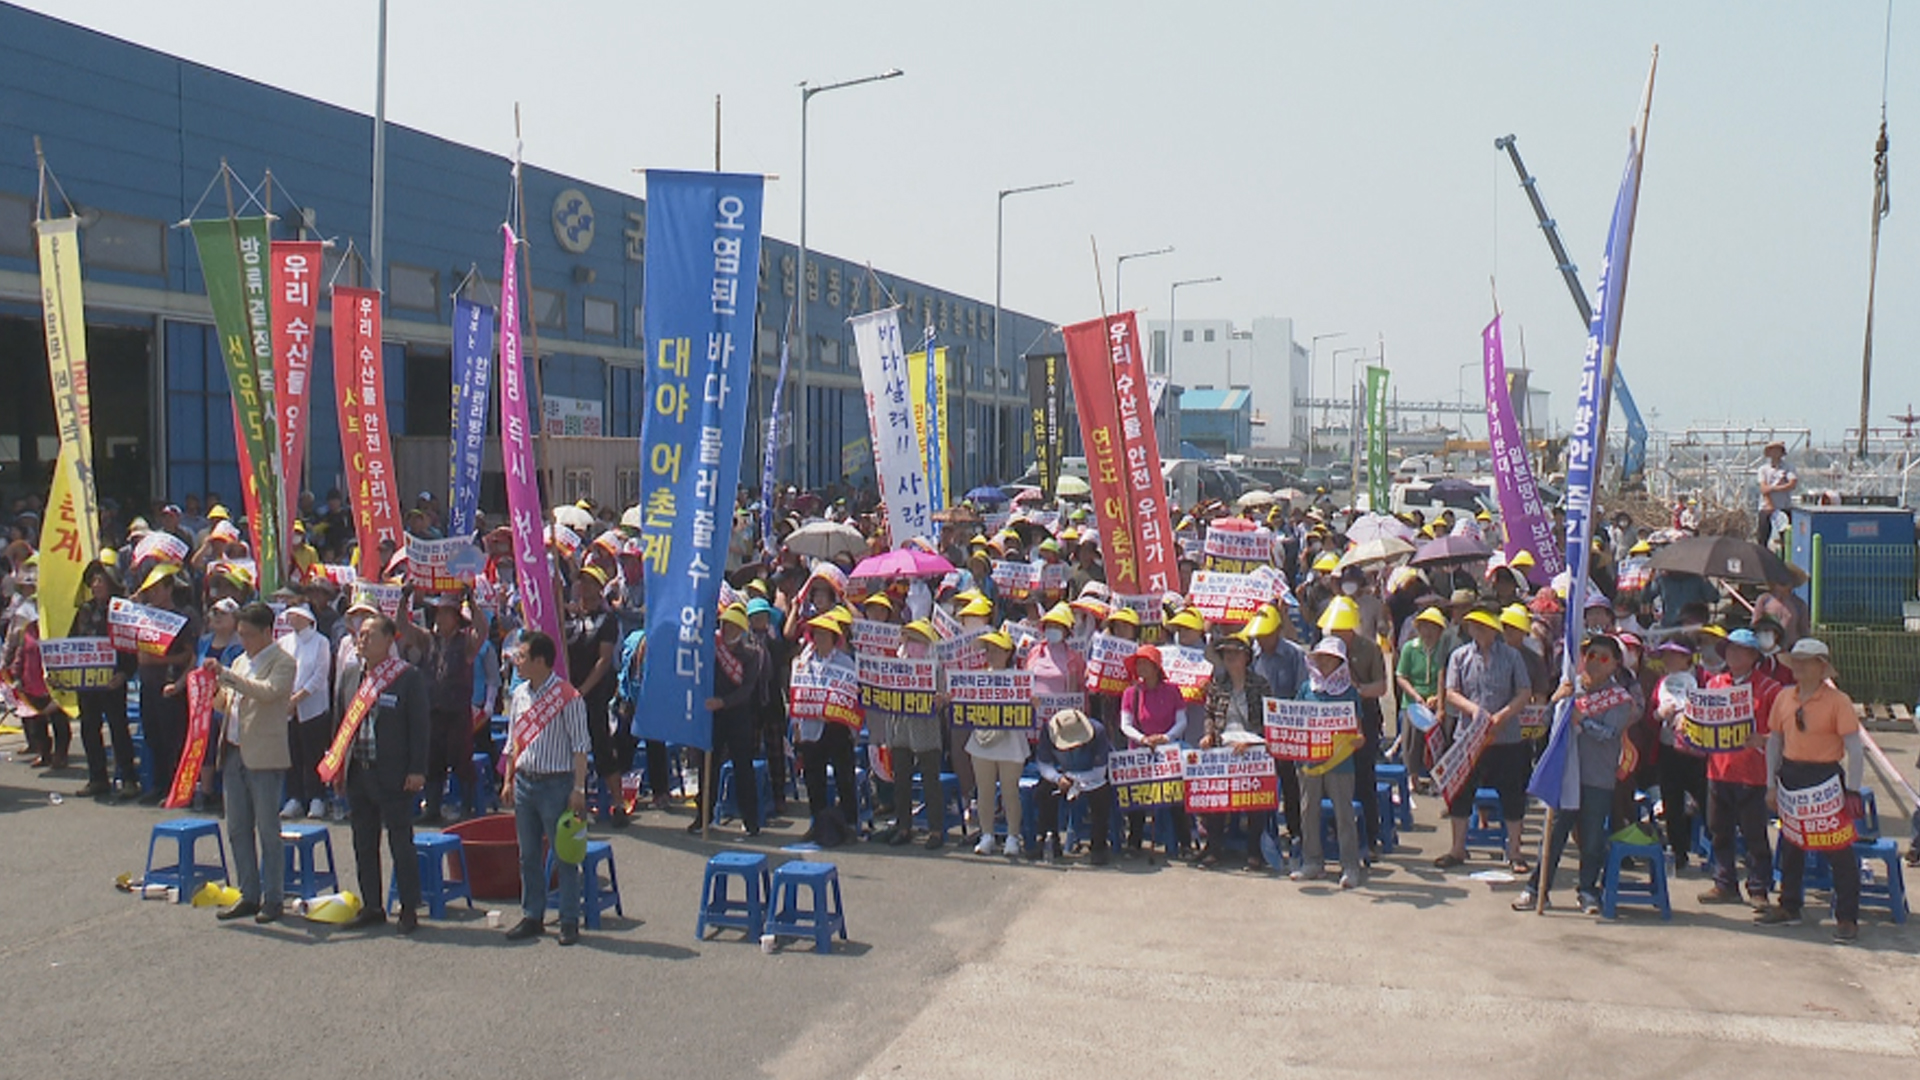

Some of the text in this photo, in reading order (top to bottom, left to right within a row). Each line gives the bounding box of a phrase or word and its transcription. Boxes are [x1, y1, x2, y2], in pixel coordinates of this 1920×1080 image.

[283, 255, 309, 306] 우리
[711, 195, 745, 316] 오염된
[359, 297, 372, 338] 우리
[1109, 322, 1132, 365] 우리
[286, 317, 310, 394] 수산물
[360, 345, 377, 406] 수산물
[704, 332, 735, 410] 바다
[364, 412, 381, 453] 안전
[1116, 373, 1142, 440] 수산물
[642, 337, 691, 575] 대야 어촌계
[1091, 425, 1119, 484] 연도
[1127, 445, 1152, 491] 안전
[369, 461, 393, 519] 우리가
[1104, 496, 1136, 584] 어촌계
[1138, 497, 1165, 563] 우리가
[675, 607, 704, 720] 없다!
